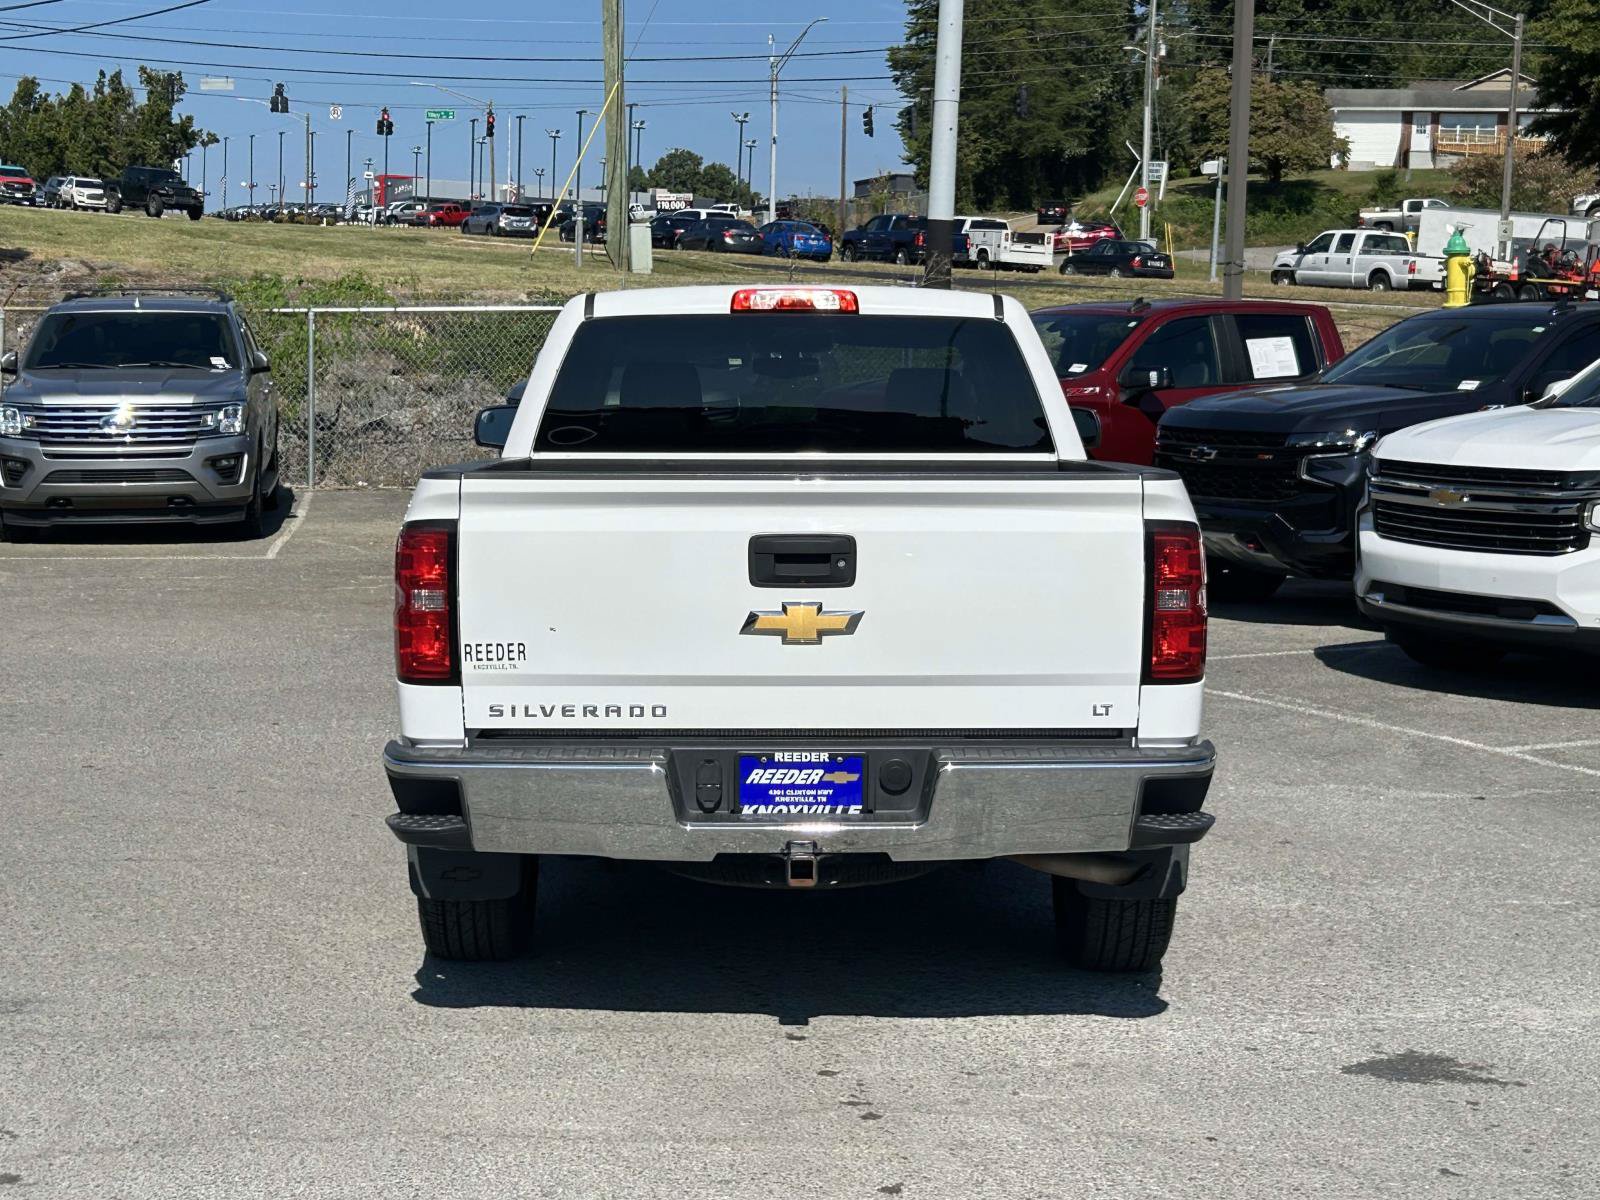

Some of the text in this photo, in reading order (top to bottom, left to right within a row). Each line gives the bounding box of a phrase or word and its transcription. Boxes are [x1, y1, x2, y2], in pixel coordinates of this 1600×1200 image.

[464, 643, 527, 661] REEDER
[489, 704, 667, 718] SILVERADO
[1092, 704, 1113, 716] LT
[774, 752, 830, 762] REEDER
[745, 769, 825, 784] REEDER
